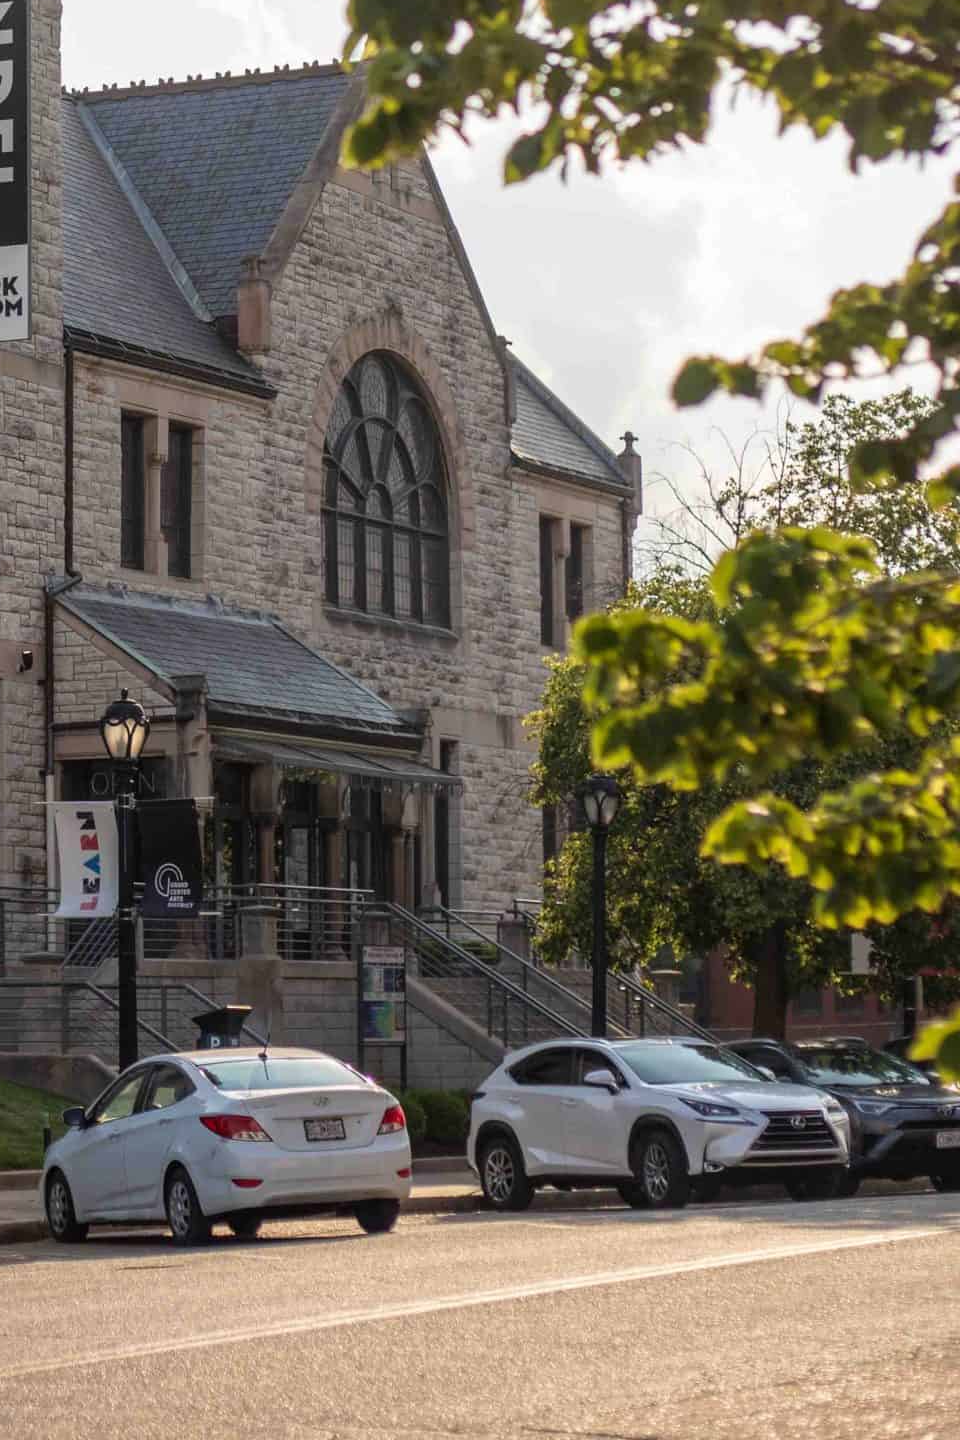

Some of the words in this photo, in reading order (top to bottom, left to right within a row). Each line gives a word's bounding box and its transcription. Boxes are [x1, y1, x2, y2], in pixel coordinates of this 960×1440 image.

[91, 771, 155, 795] ON
[76, 811, 101, 911] LEARN
[211, 1036, 220, 1048] P
